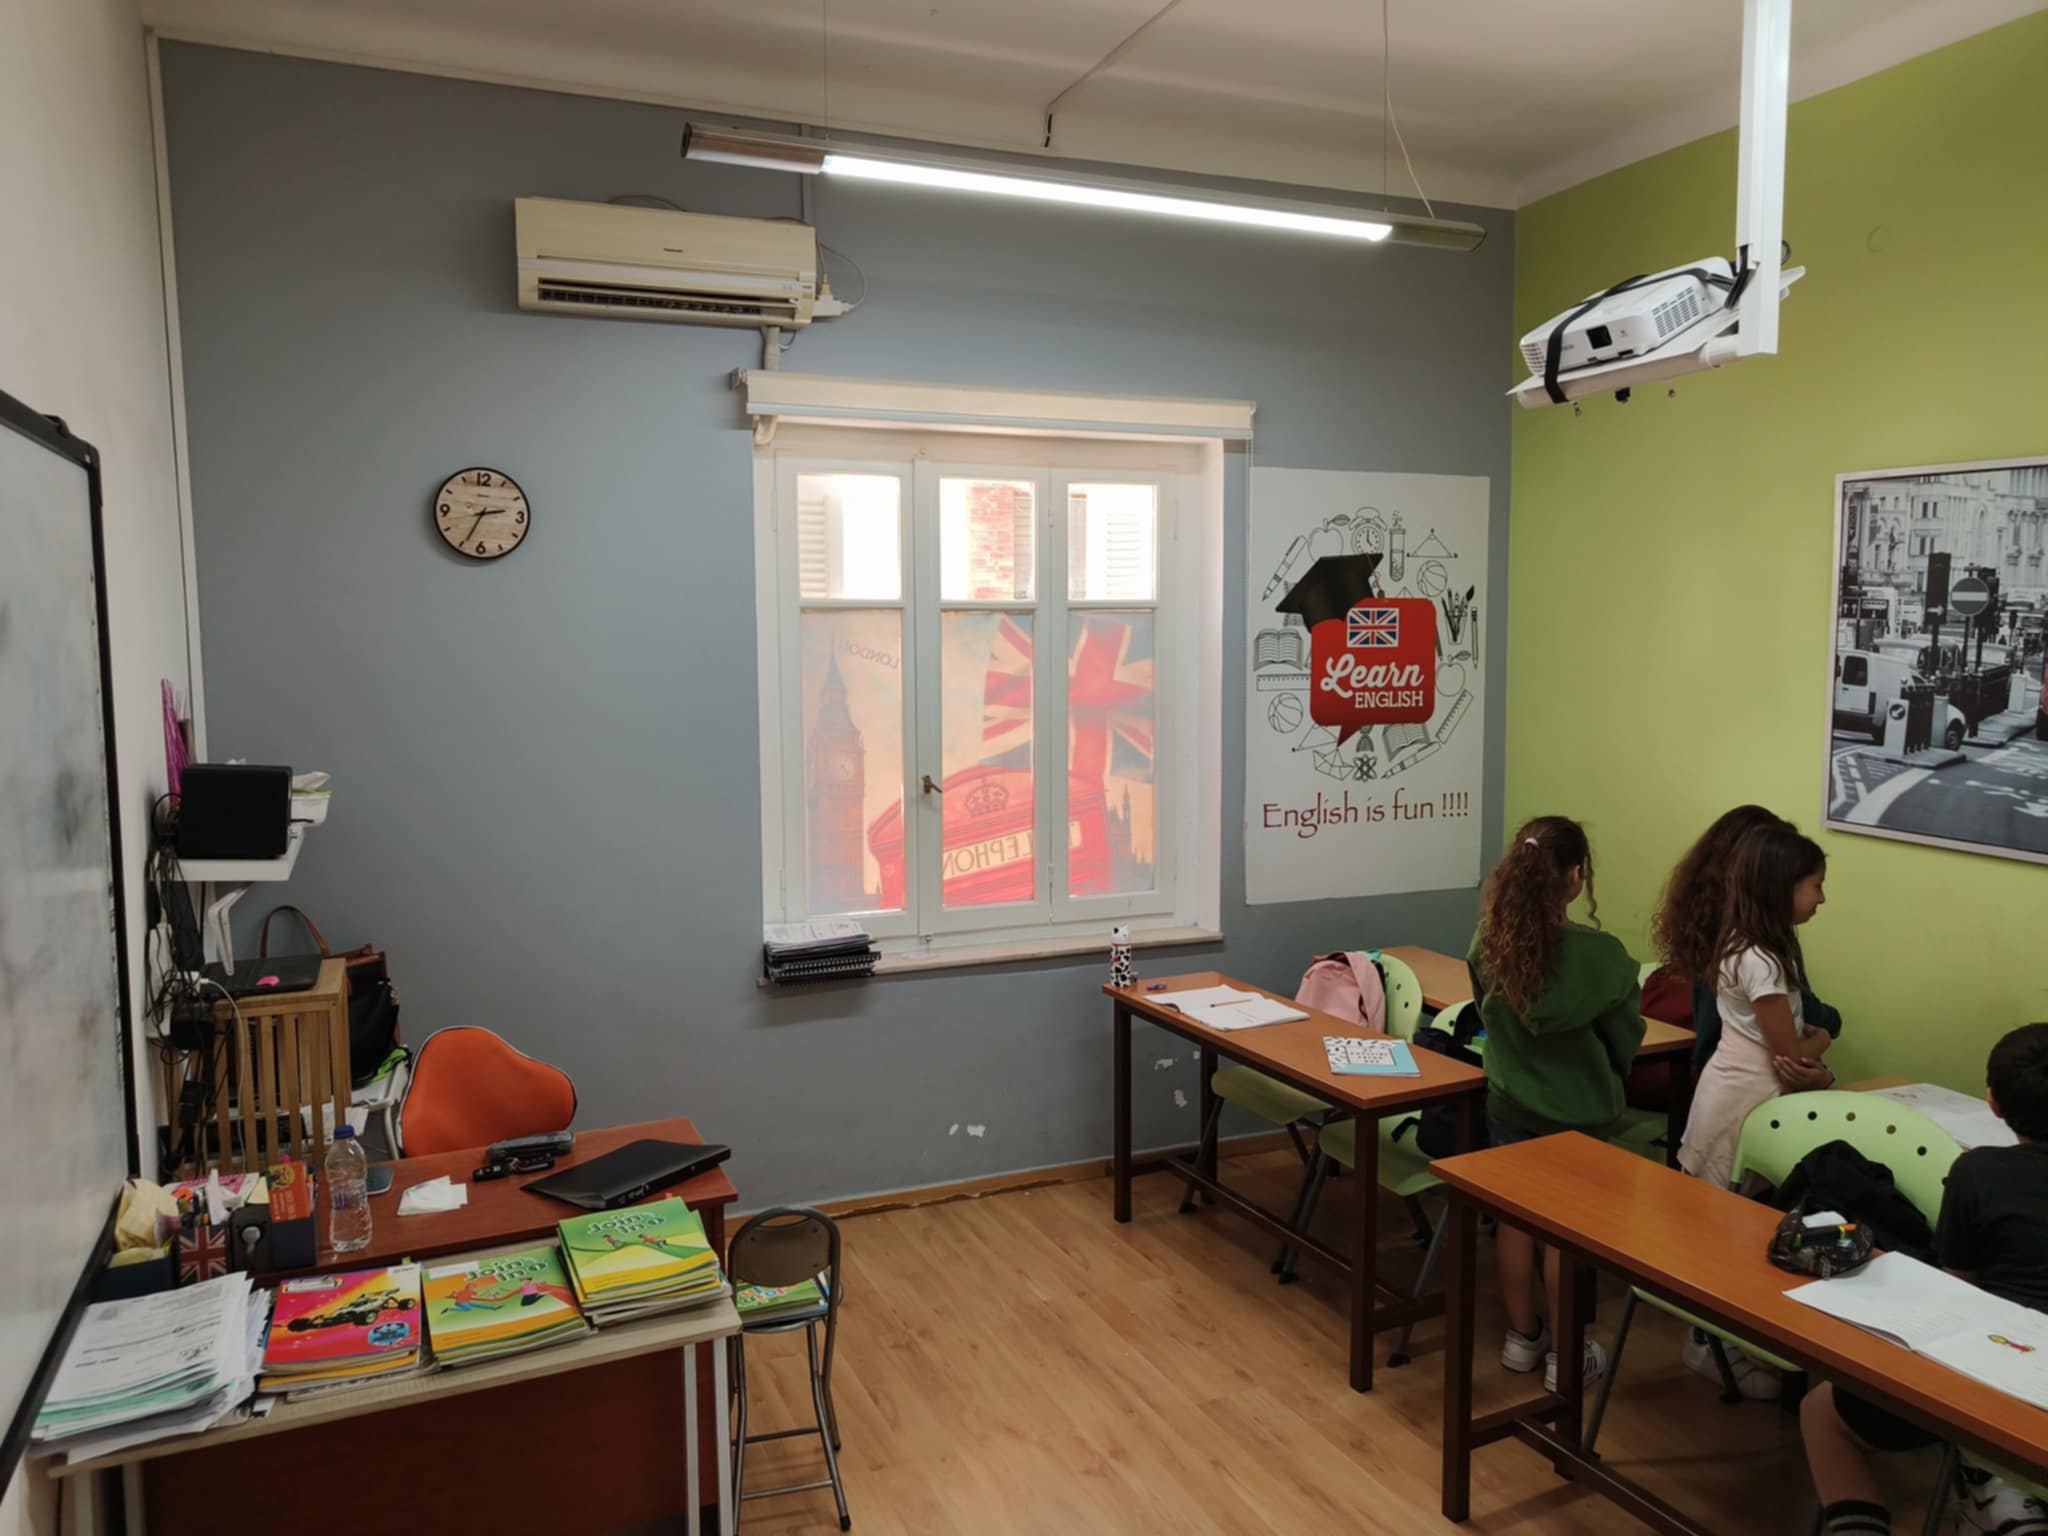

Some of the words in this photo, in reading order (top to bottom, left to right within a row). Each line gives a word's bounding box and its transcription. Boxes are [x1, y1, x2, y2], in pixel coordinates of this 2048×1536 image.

[476, 472, 491, 487] 12
[440, 503, 450, 517] 9
[515, 511, 525, 524] 3
[475, 541, 486, 554] 6
[1320, 654, 1424, 699] Learn
[1355, 690, 1424, 709] ENGLISH
[1263, 789, 1359, 839] English
[1366, 796, 1385, 822] is
[1392, 787, 1434, 821] fun
[1441, 791, 1469, 818] !!!!
[588, 1214, 642, 1235] Join
[464, 1260, 523, 1282] Join
